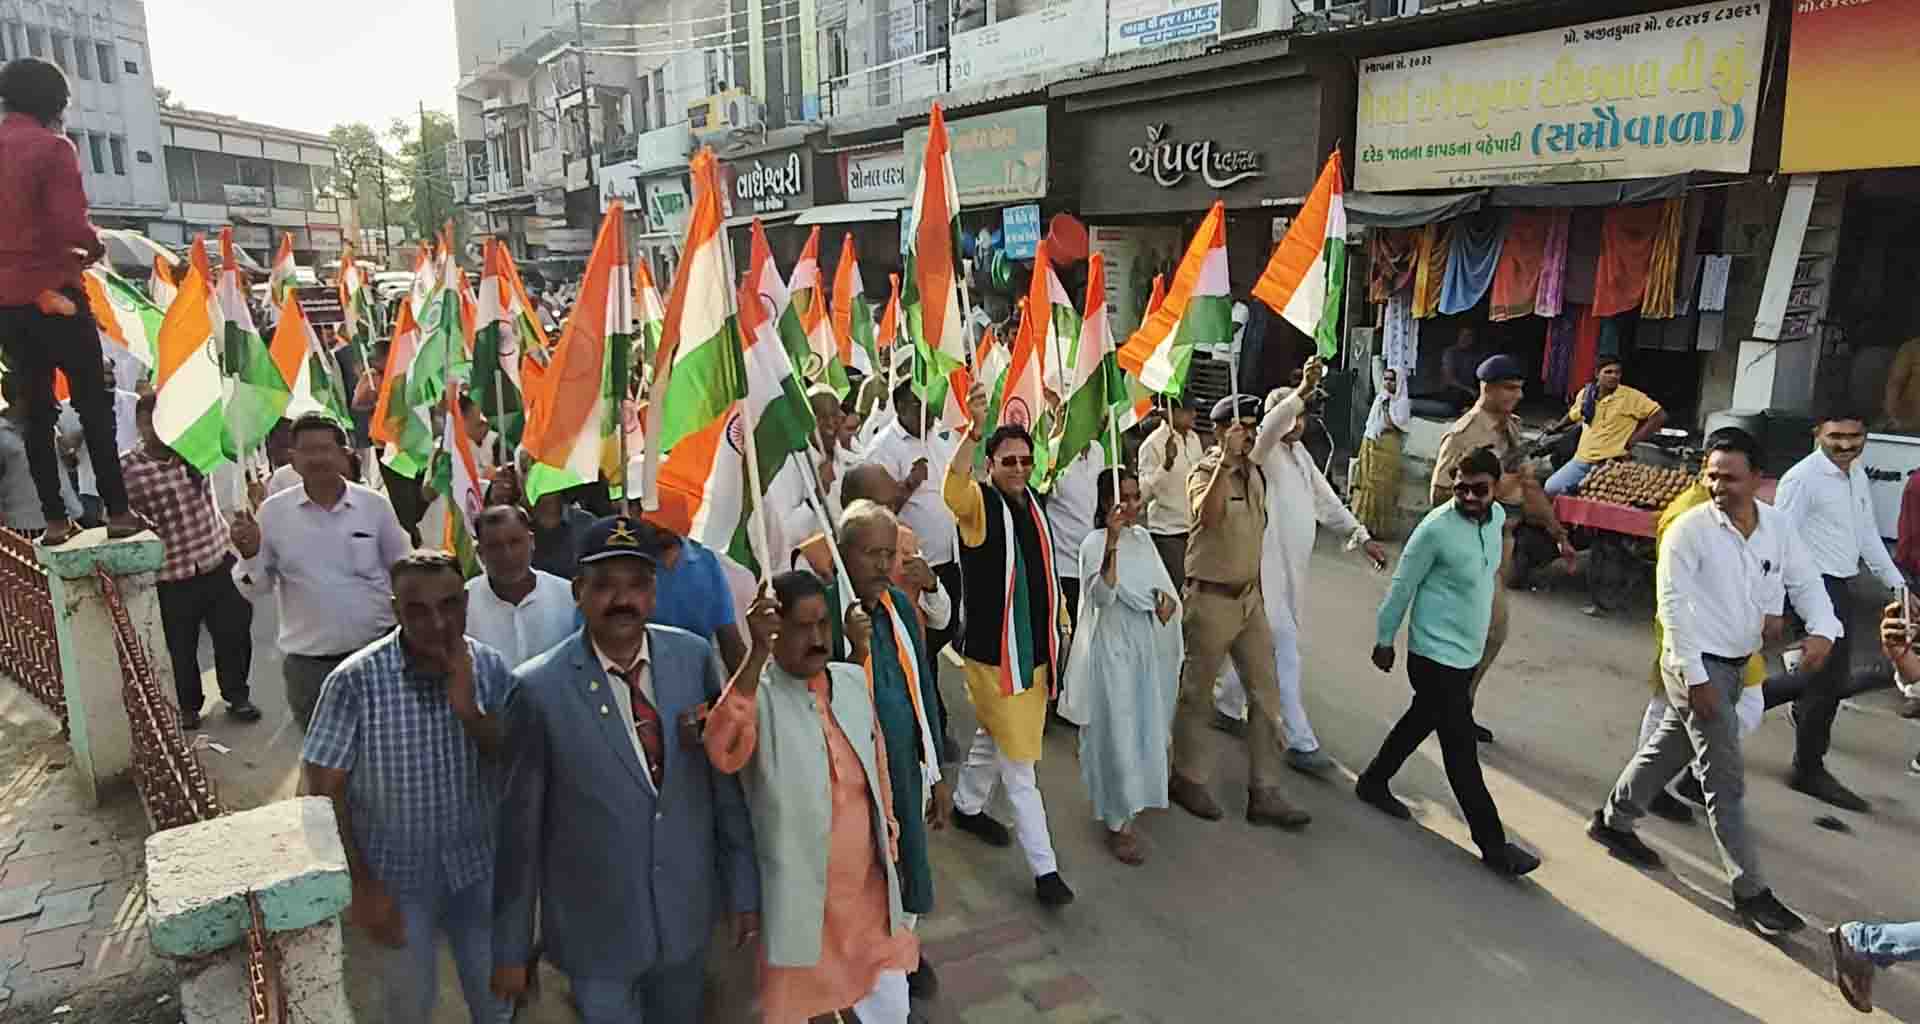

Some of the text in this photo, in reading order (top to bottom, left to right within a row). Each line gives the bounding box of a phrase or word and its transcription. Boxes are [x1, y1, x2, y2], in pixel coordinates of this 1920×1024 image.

[1644, 15, 1661, 33] મો.
[1361, 131, 1522, 164] દરેક જાતના કાપડના વહેપારી
